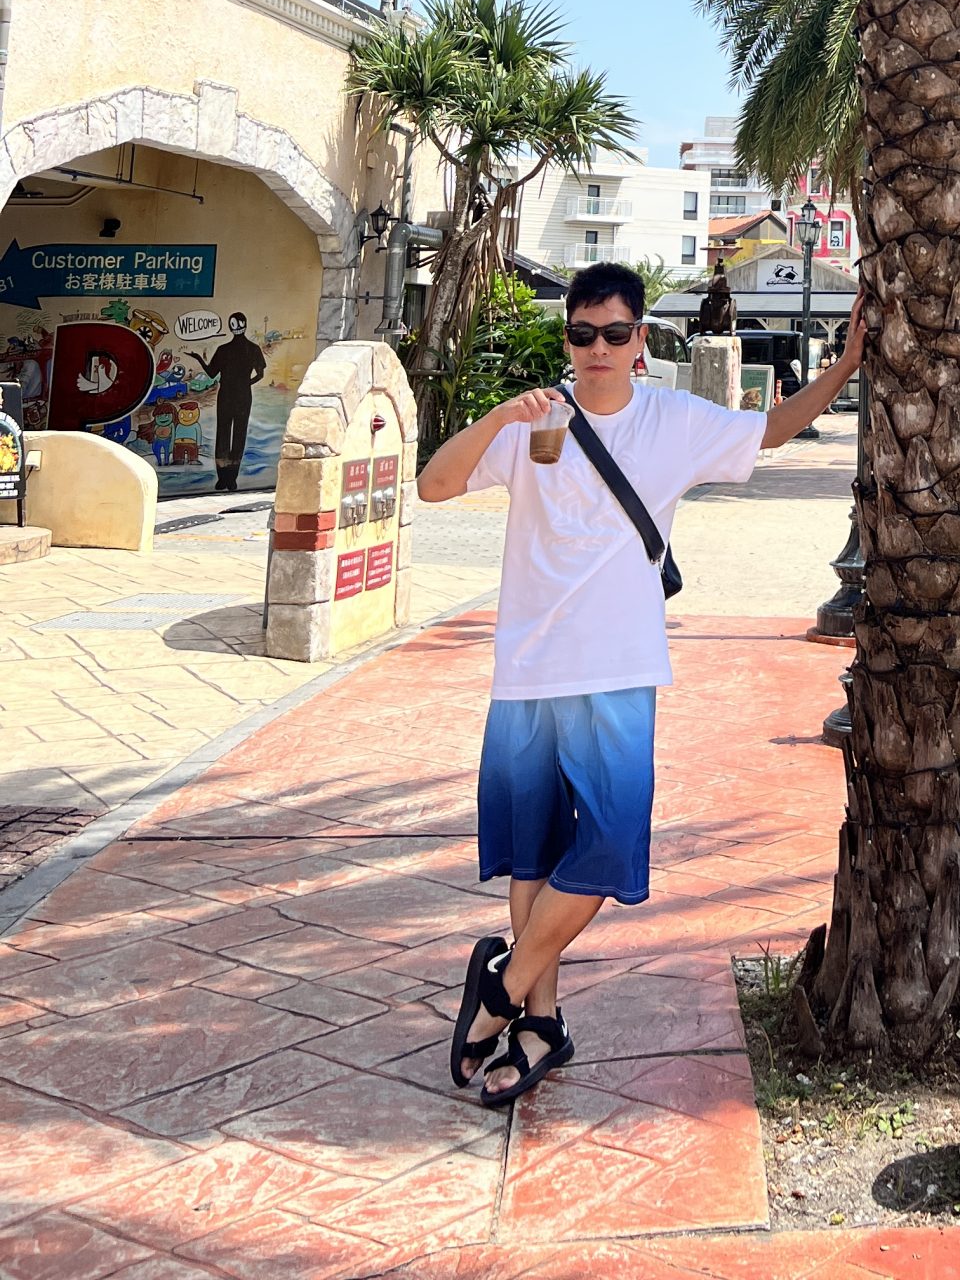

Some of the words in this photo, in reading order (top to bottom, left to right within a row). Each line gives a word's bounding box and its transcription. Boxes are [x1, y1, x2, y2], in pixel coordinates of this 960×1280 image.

[32, 251, 124, 269] Customer
[134, 252, 203, 273] Parking
[65, 273, 167, 291] お客様駐車場
